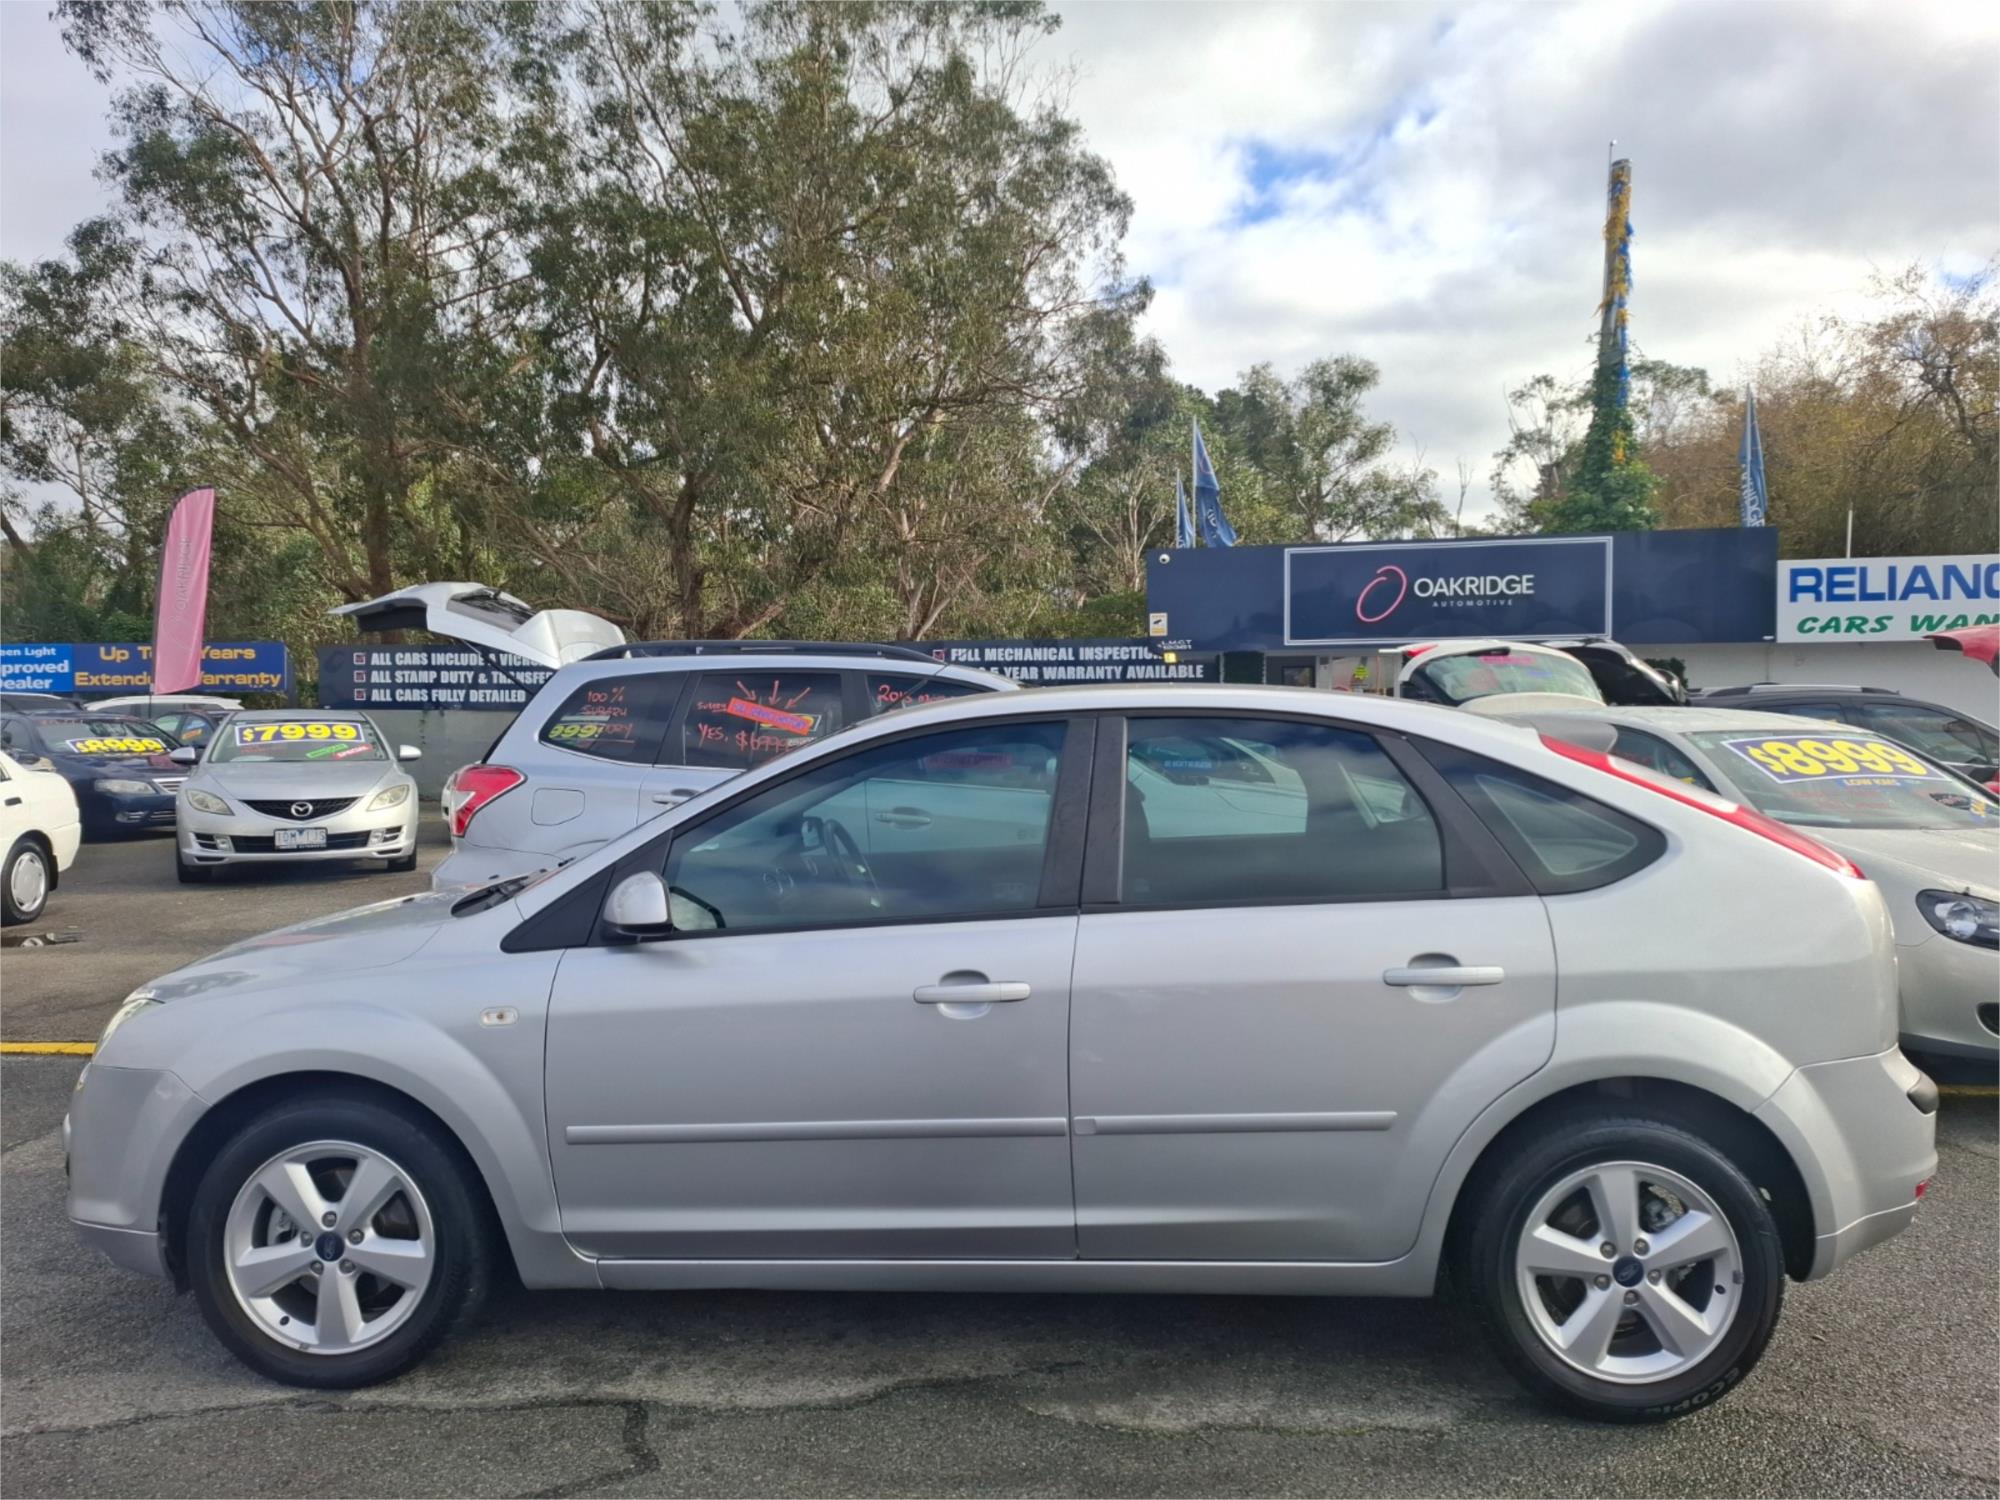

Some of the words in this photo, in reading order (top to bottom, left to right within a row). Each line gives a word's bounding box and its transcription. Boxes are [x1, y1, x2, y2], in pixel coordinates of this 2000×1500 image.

[1414, 575, 1535, 597] OAKRIDGE
[1432, 599, 1513, 607] AUTOMOTIVE
[1796, 615, 1894, 634] CARS
[100, 646, 129, 662] Up
[371, 652, 392, 665] ALL
[395, 652, 428, 666] CARS
[431, 652, 485, 666] INCLUDE
[951, 648, 981, 662] FULL
[985, 647, 1075, 661] MECHANICAL
[75, 672, 151, 686] Extend
[200, 671, 281, 688] arranty
[371, 670, 392, 683] ALL
[395, 670, 437, 683] STAMP
[441, 670, 474, 683] DUTY
[1003, 666, 1038, 680] YEAR
[1042, 665, 1122, 680] WARRANTY
[1126, 665, 1204, 679] AVAILABLE
[0, 676, 52, 689] ealer
[371, 689, 392, 702] ALL
[395, 689, 428, 702] CARS
[431, 689, 466, 702] FULLY
[470, 689, 526, 703] DETAILED
[242, 723, 358, 741] $7999
[1746, 740, 1927, 775] $8999
